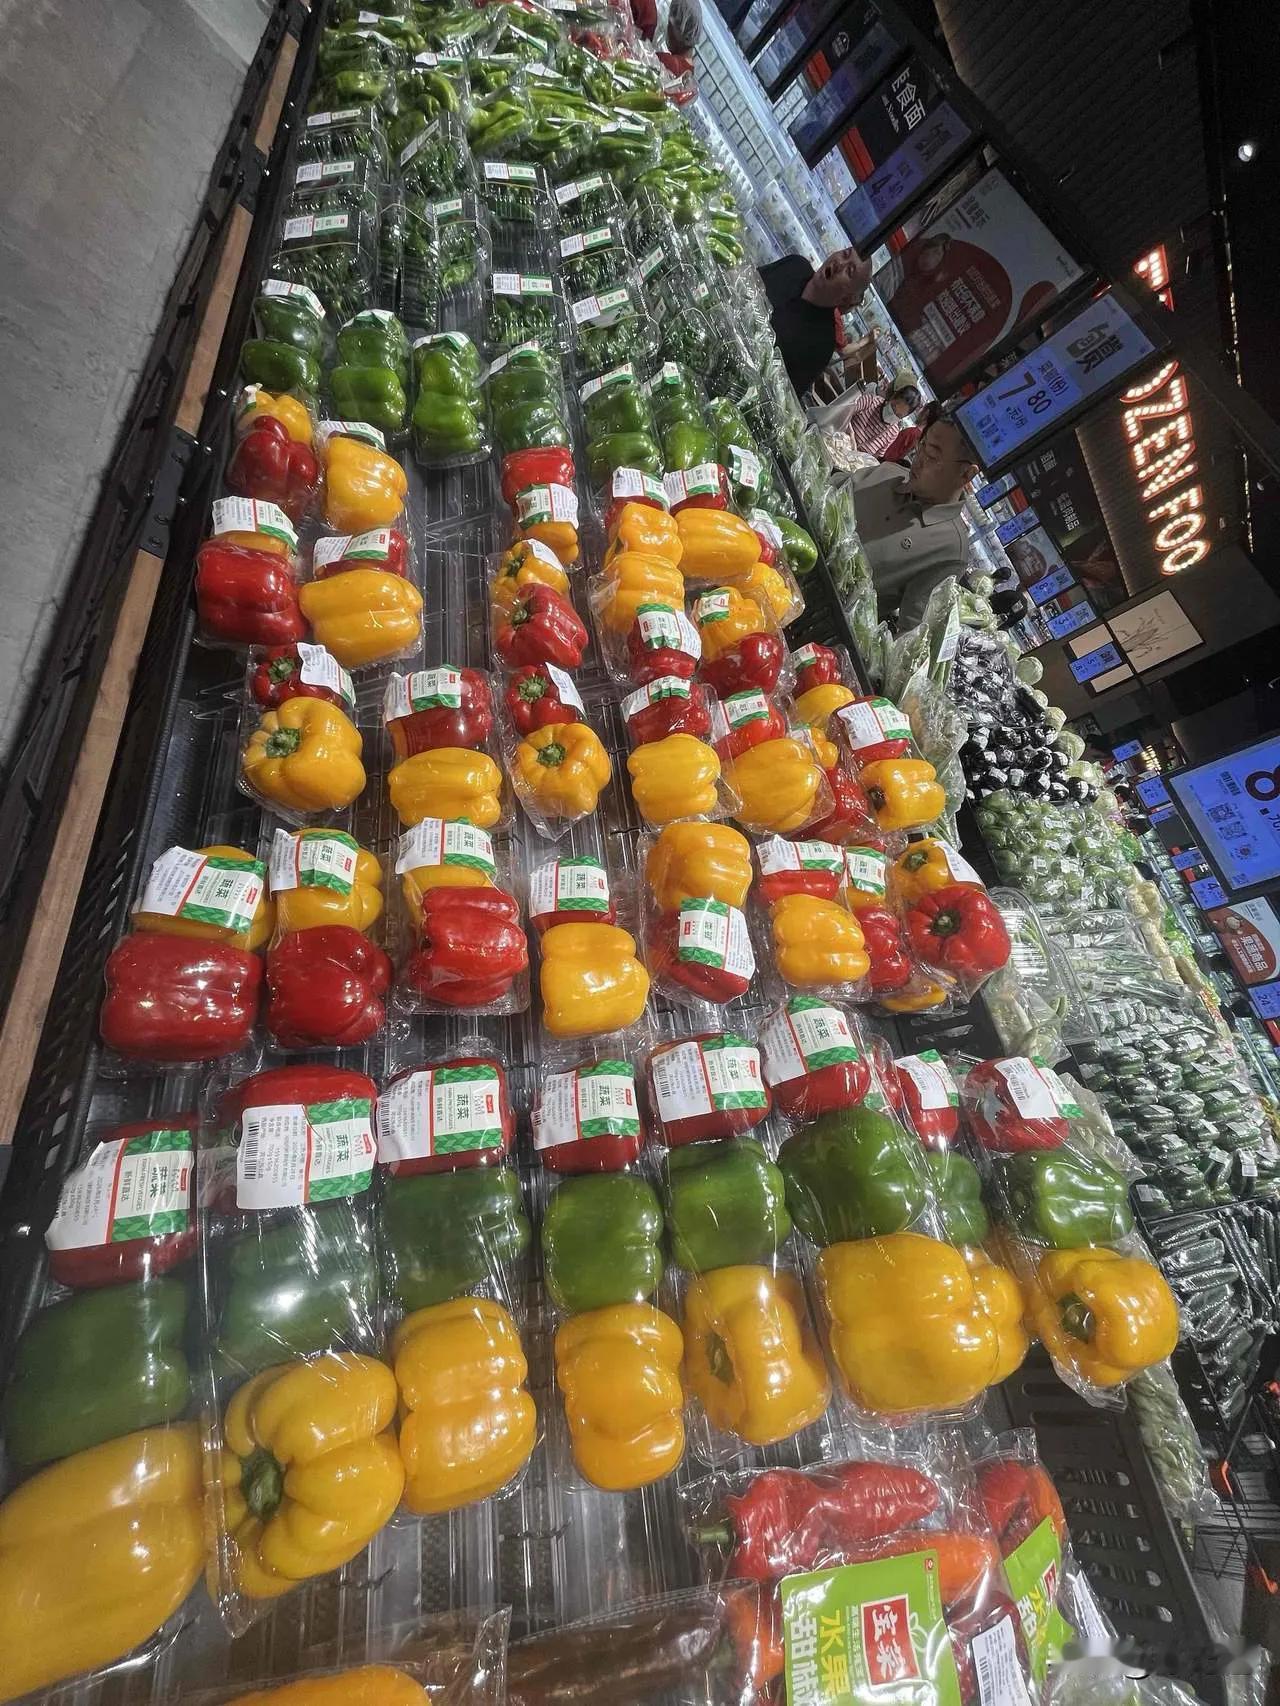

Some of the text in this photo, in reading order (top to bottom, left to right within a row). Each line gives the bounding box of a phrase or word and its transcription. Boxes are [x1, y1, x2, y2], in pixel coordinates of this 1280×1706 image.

[813, 1017, 830, 1040] 蔬菜
[457, 1094, 469, 1120] 蔬菜
[599, 1085, 610, 1107] 蔬菜
[336, 1134, 349, 1163] 蔬菜
[150, 1165, 167, 1199] 蔬菜
[817, 1608, 851, 1698] 水果
[870, 1603, 908, 1682] 宝菜
